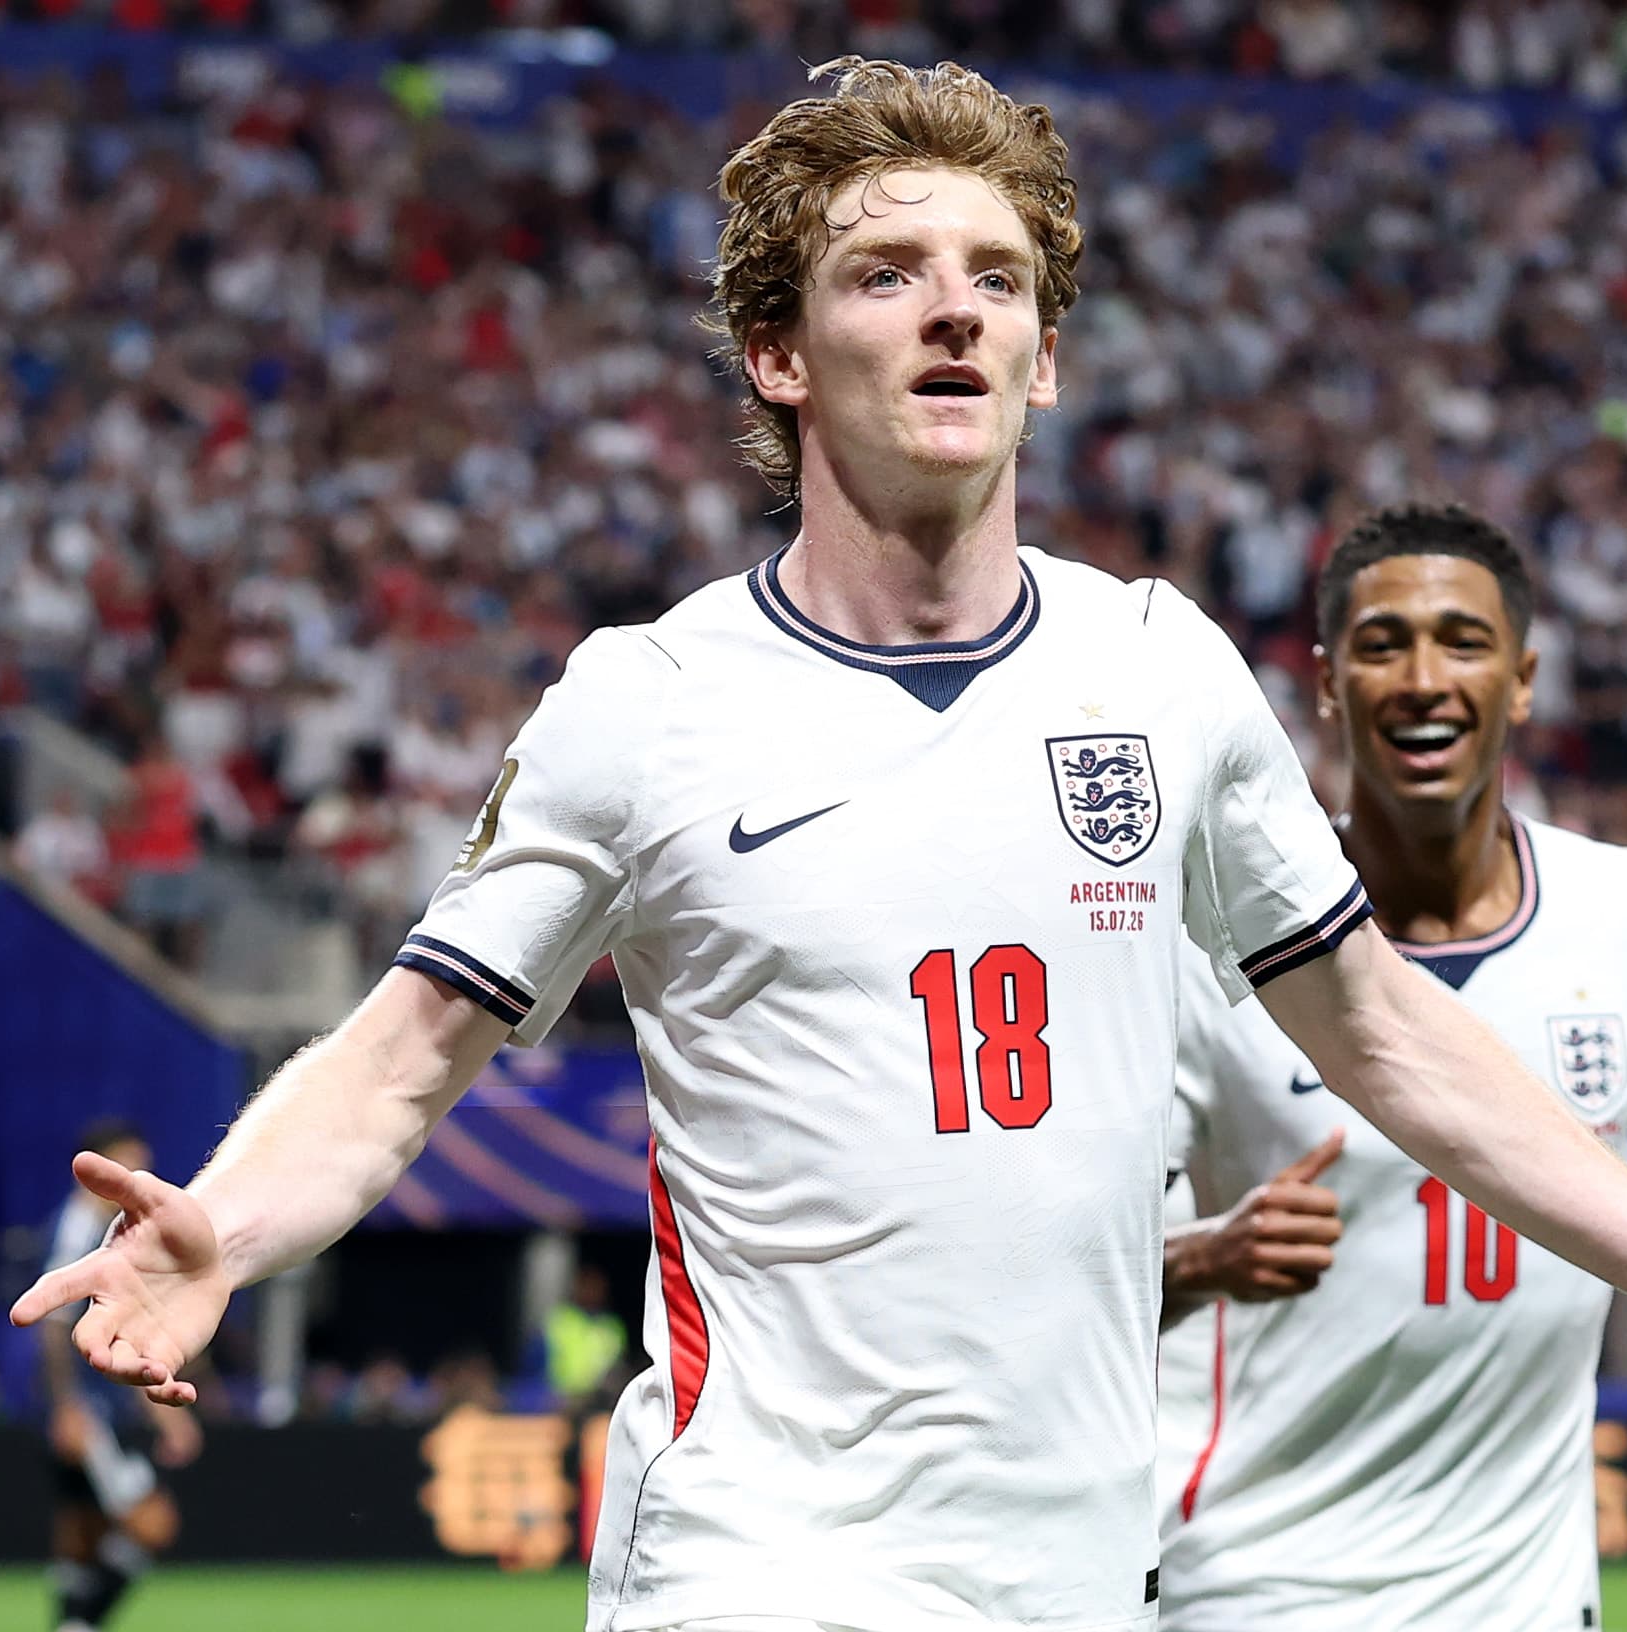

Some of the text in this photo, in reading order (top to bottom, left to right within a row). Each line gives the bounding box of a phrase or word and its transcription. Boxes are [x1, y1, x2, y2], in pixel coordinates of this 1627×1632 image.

[1070, 881, 1157, 904] ARGENTINA
[1089, 910, 1144, 932] 15.07.26
[910, 944, 1052, 1134] 18
[1416, 1176, 1518, 1305] 10
